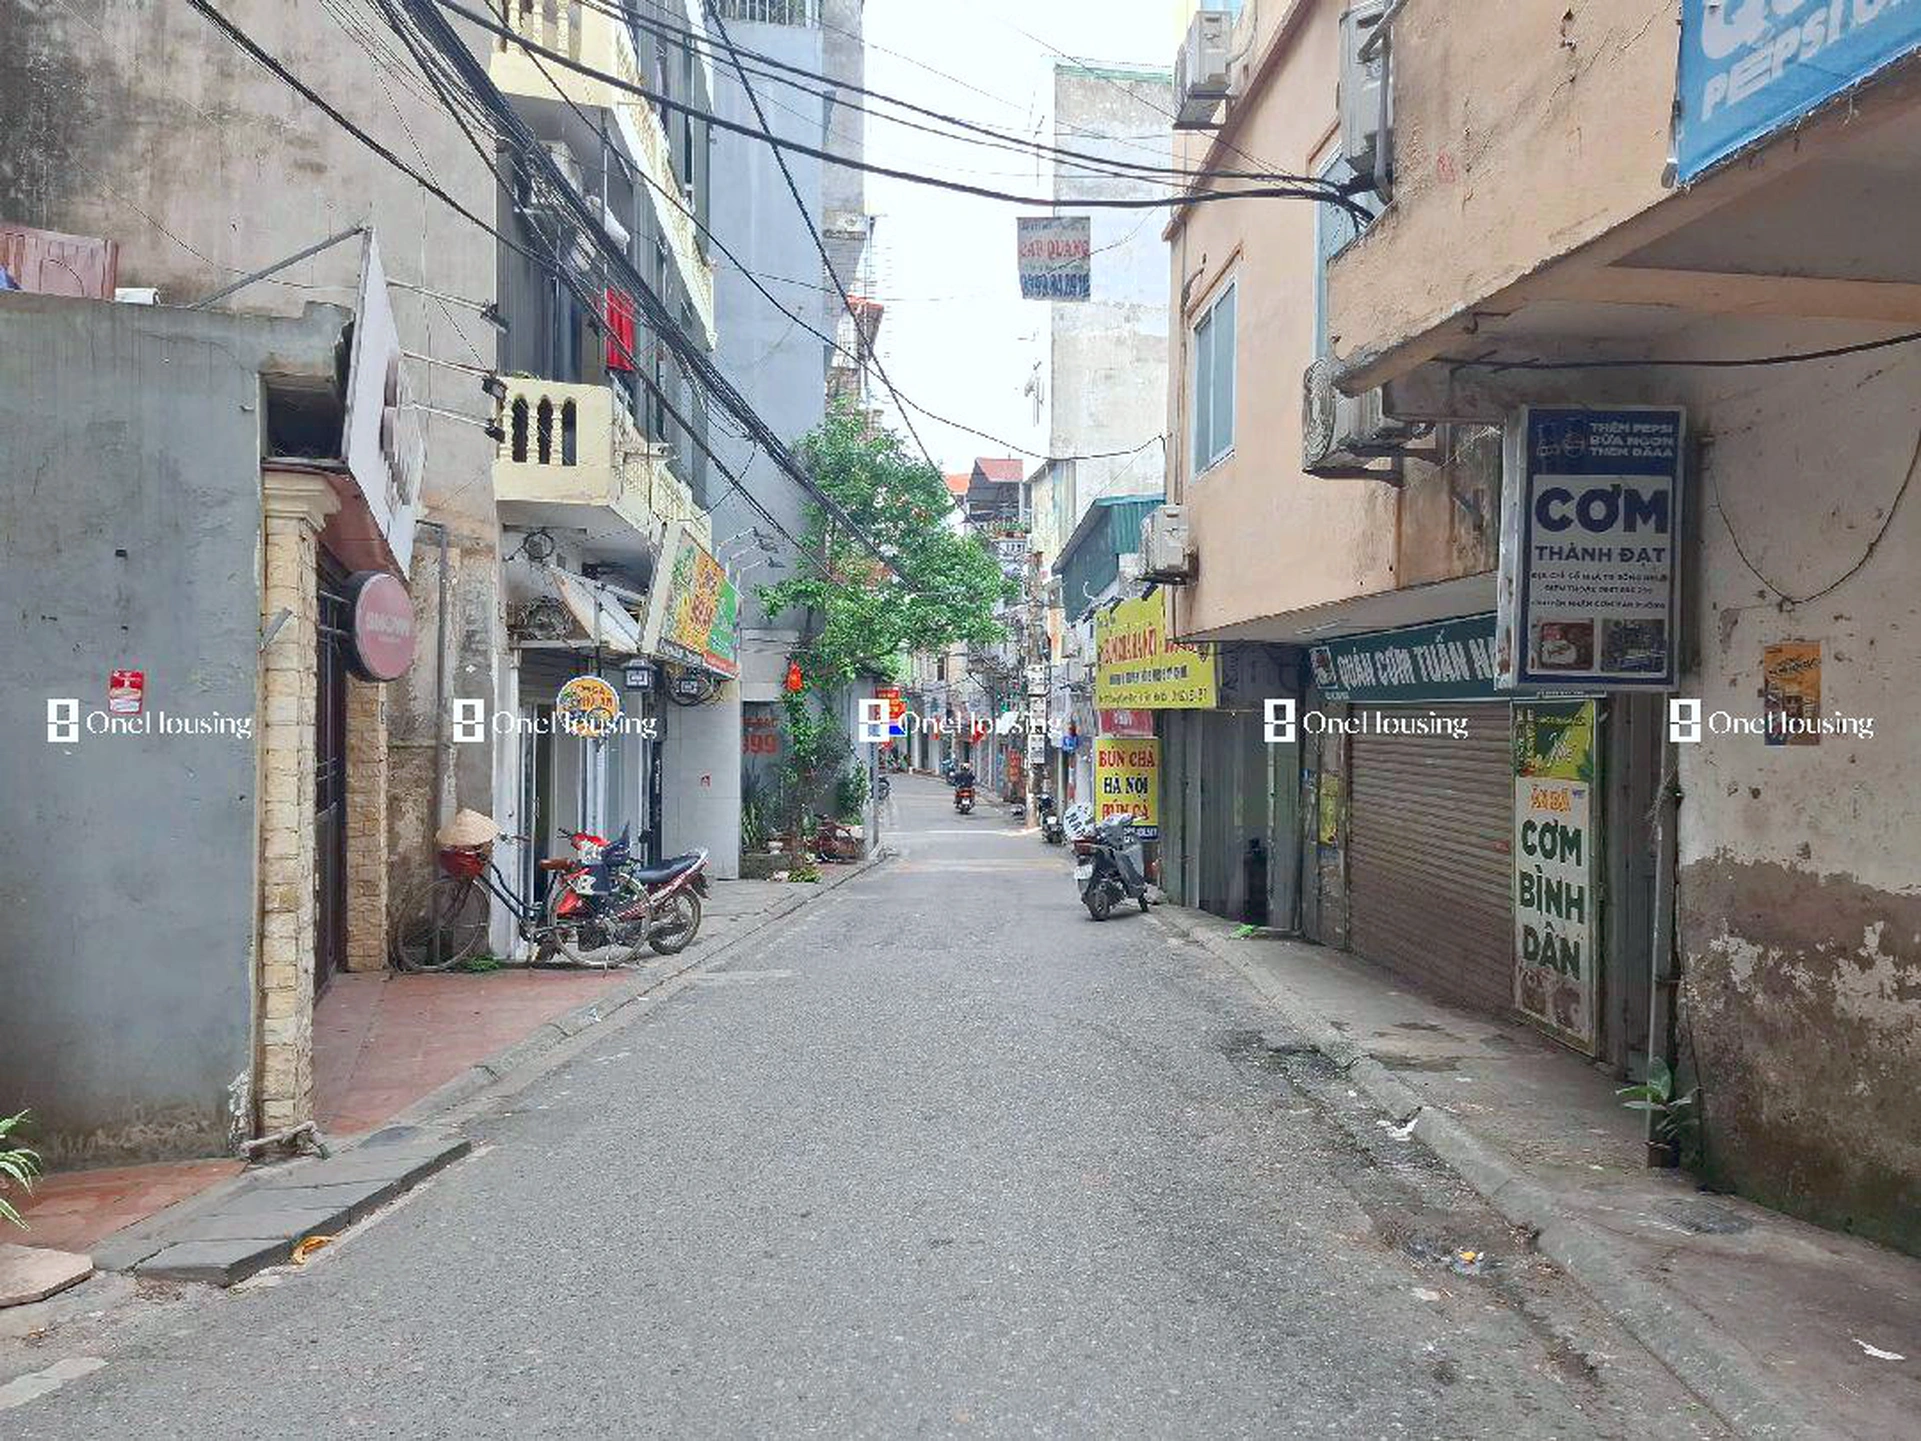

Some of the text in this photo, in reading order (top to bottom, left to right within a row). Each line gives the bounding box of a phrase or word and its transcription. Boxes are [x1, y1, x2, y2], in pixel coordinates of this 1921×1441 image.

[1701, 0, 1846, 122] PEPSI
[1632, 423, 1673, 434] PEPSI
[1534, 483, 1669, 533] CƠM
[1619, 547, 1666, 567] ĐẠT
[1337, 647, 1376, 690] QUÁN
[1375, 645, 1416, 687] CƠM
[1413, 628, 1471, 683] TUẤN
[1099, 745, 1126, 768] BÚN
[1103, 772, 1149, 798] HÀ NỘI
[1521, 818, 1582, 867] CƠM
[1520, 864, 1585, 924] BÌNH
[1523, 921, 1580, 981] DÂN
